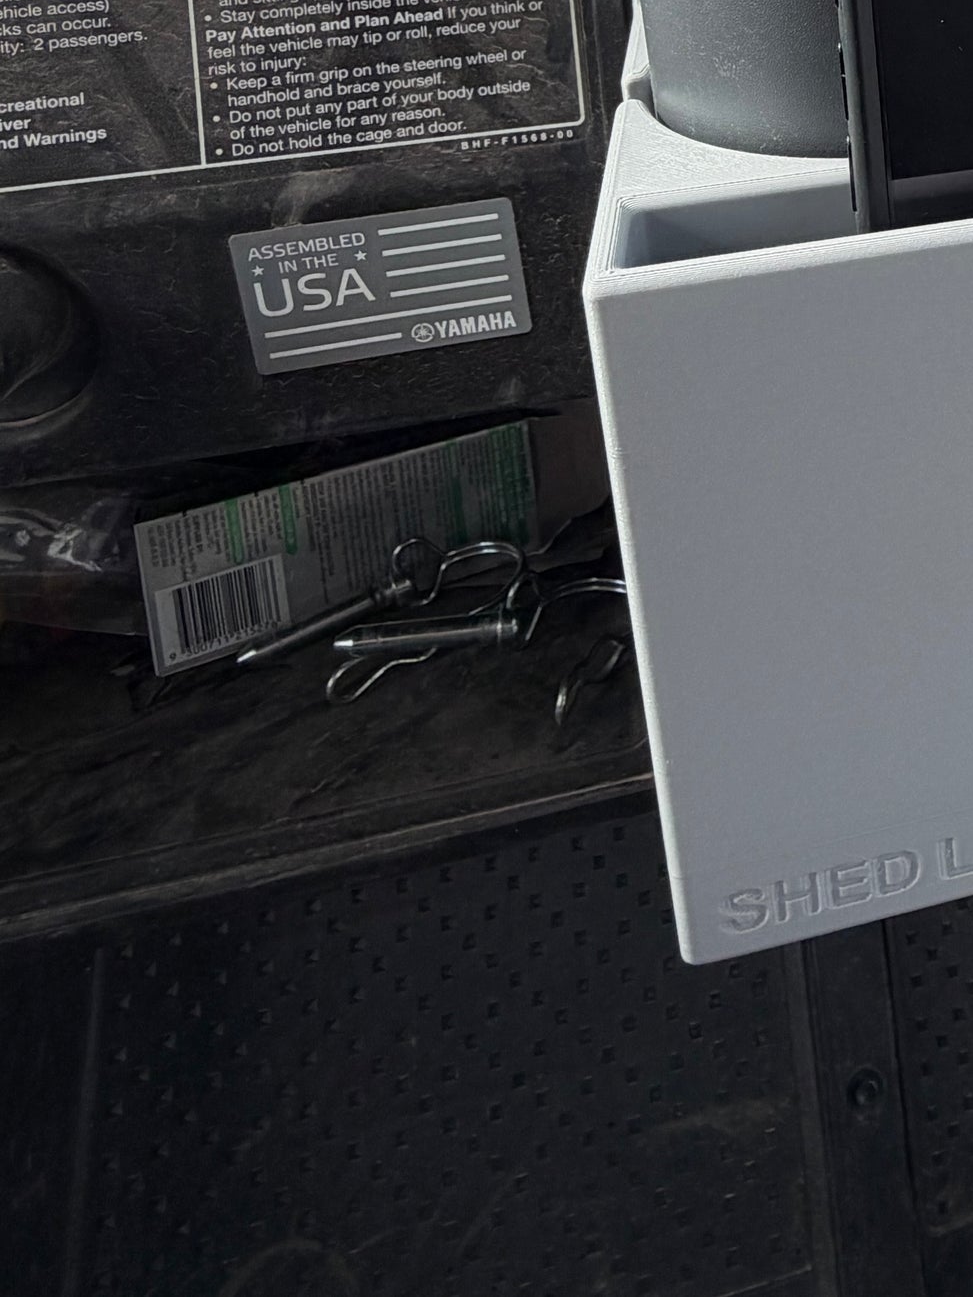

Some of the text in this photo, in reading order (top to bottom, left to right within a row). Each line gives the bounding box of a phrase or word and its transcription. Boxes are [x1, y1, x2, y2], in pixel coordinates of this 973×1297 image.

[25, 16, 111, 34] can occur.
[205, 0, 543, 43] Pay Attention and Plan Ahead If you think or
[220, 9, 255, 23] Stay
[258, 0, 343, 19] completely
[47, 30, 148, 52] passengers.
[206, 18, 521, 59] feel the vehicle may tip or roll, reduce your
[207, 55, 306, 75] risk to injury:
[225, 49, 526, 90] Keep firm grip on the steering wheel or
[227, 71, 446, 107] handhold and brace yourself.
[228, 79, 530, 123] Do not put any part of your body outside
[22, 128, 107, 147] Warnings
[229, 106, 445, 139] of the vehicle for any reason.
[231, 120, 467, 157] Do not hold the cage and door.
[248, 232, 365, 261] ASSEMBLED
[278, 254, 339, 274] IN THE
[253, 268, 376, 317] USA
[434, 311, 516, 339] YAMAHA
[719, 849, 921, 934] SHED
